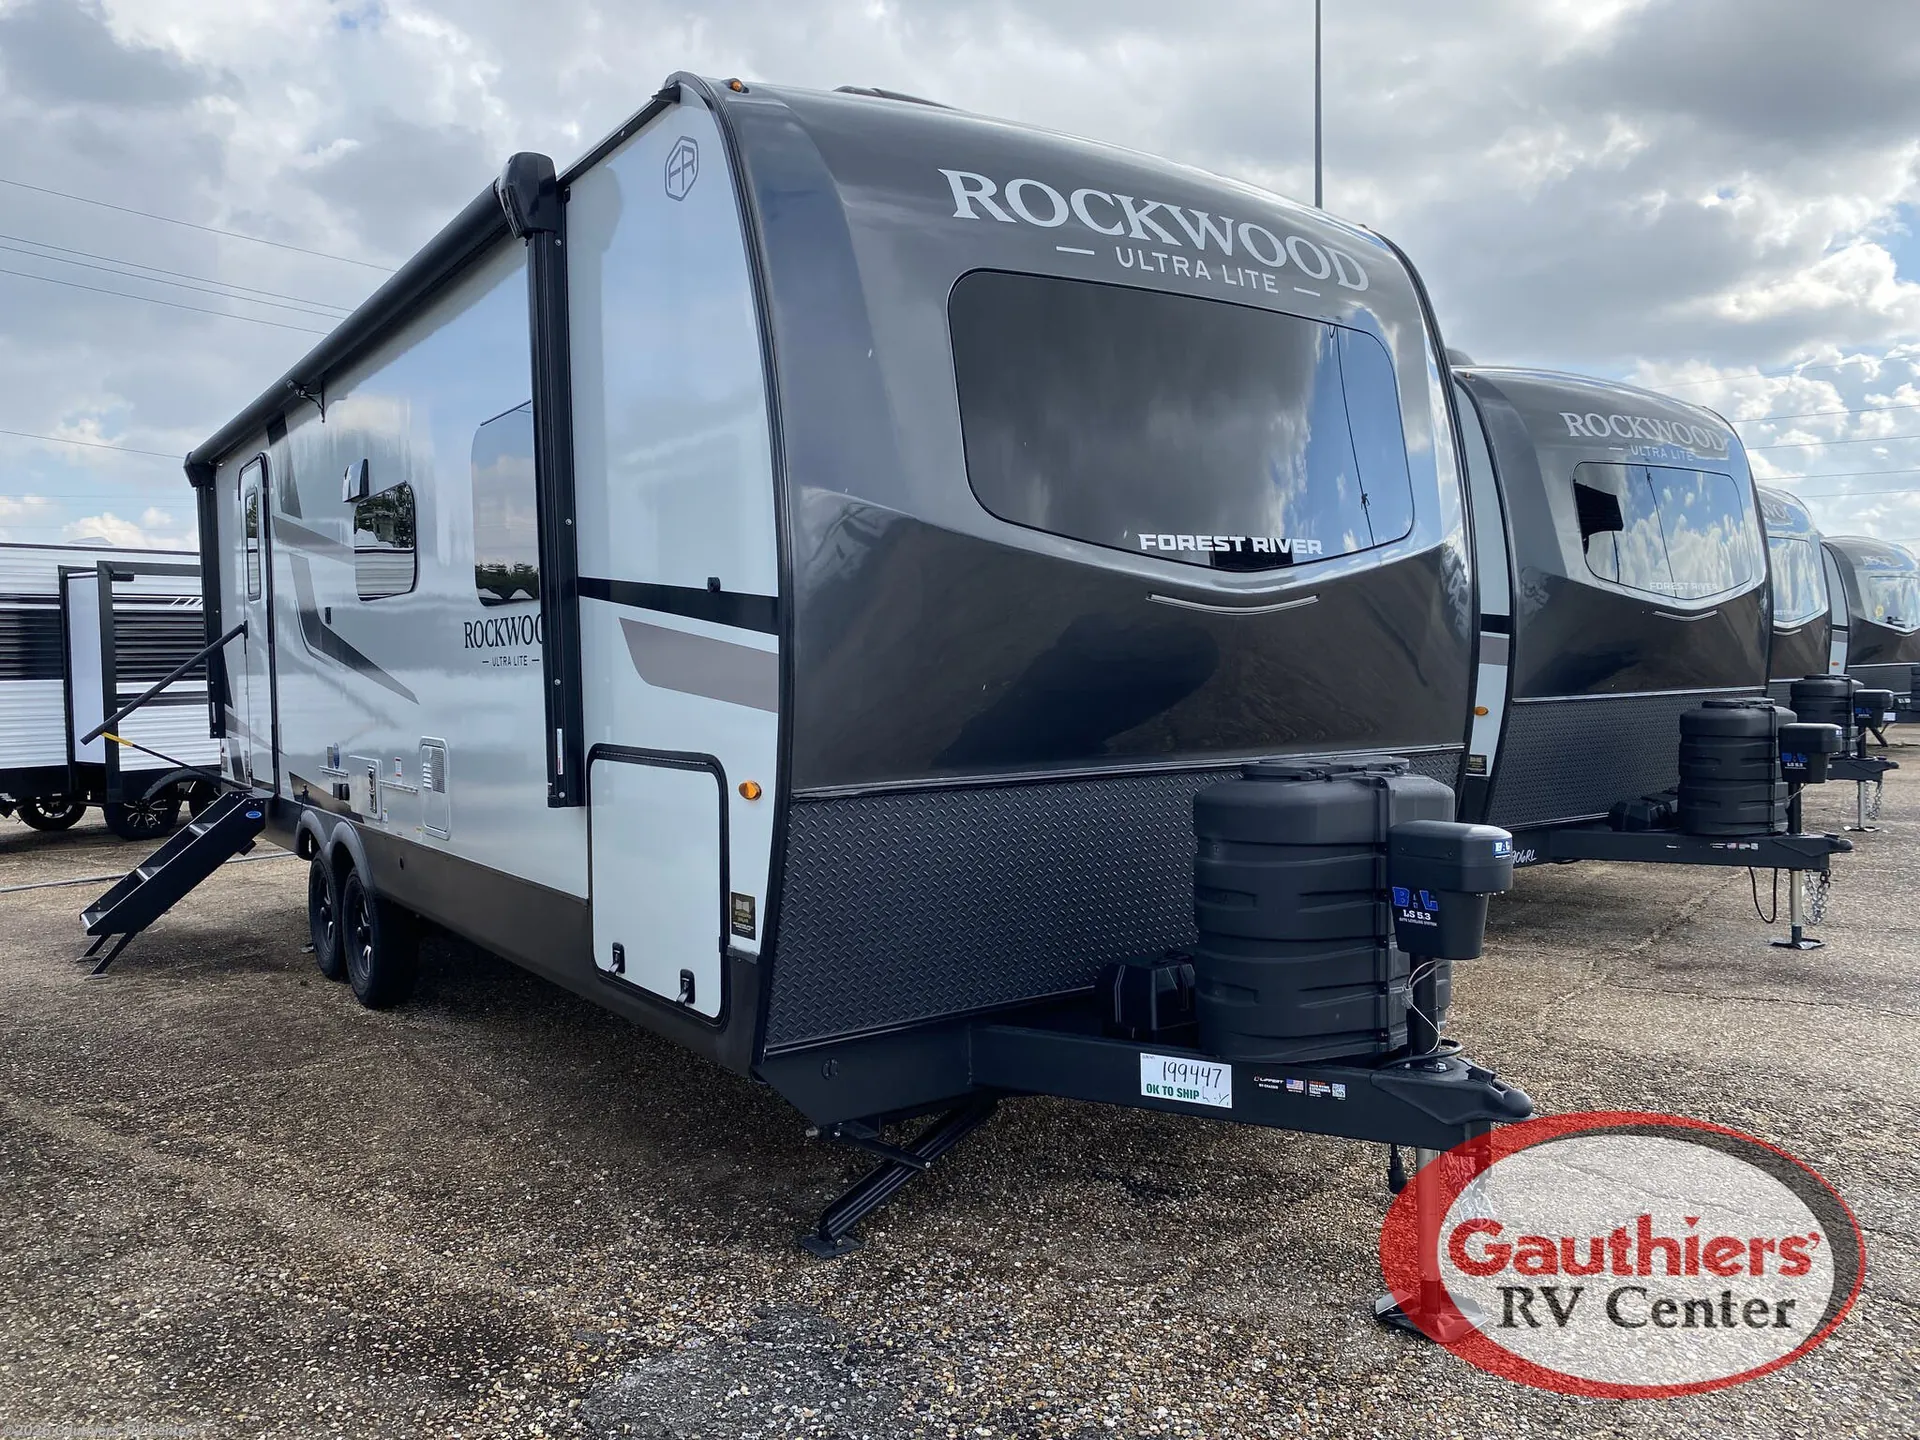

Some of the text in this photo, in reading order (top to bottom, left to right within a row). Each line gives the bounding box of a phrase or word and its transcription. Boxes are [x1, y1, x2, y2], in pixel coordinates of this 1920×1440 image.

[937, 168, 1369, 292] ROCKWOOD
[1115, 246, 1279, 294] ULTRA LITE
[1559, 412, 1729, 451] ROCKWOOD
[1630, 445, 1696, 462] ULTRA LITE
[1138, 533, 1323, 555] FOREST RIVER
[463, 614, 542, 649] ROCKWO
[491, 655, 528, 667] ULTRA LITE
[1402, 909, 1416, 919] LS
[1162, 1061, 1222, 1088] 199447
[1146, 1083, 1160, 1096] OK
[1162, 1085, 1174, 1097] TO
[1177, 1087, 1200, 1100] SHIP
